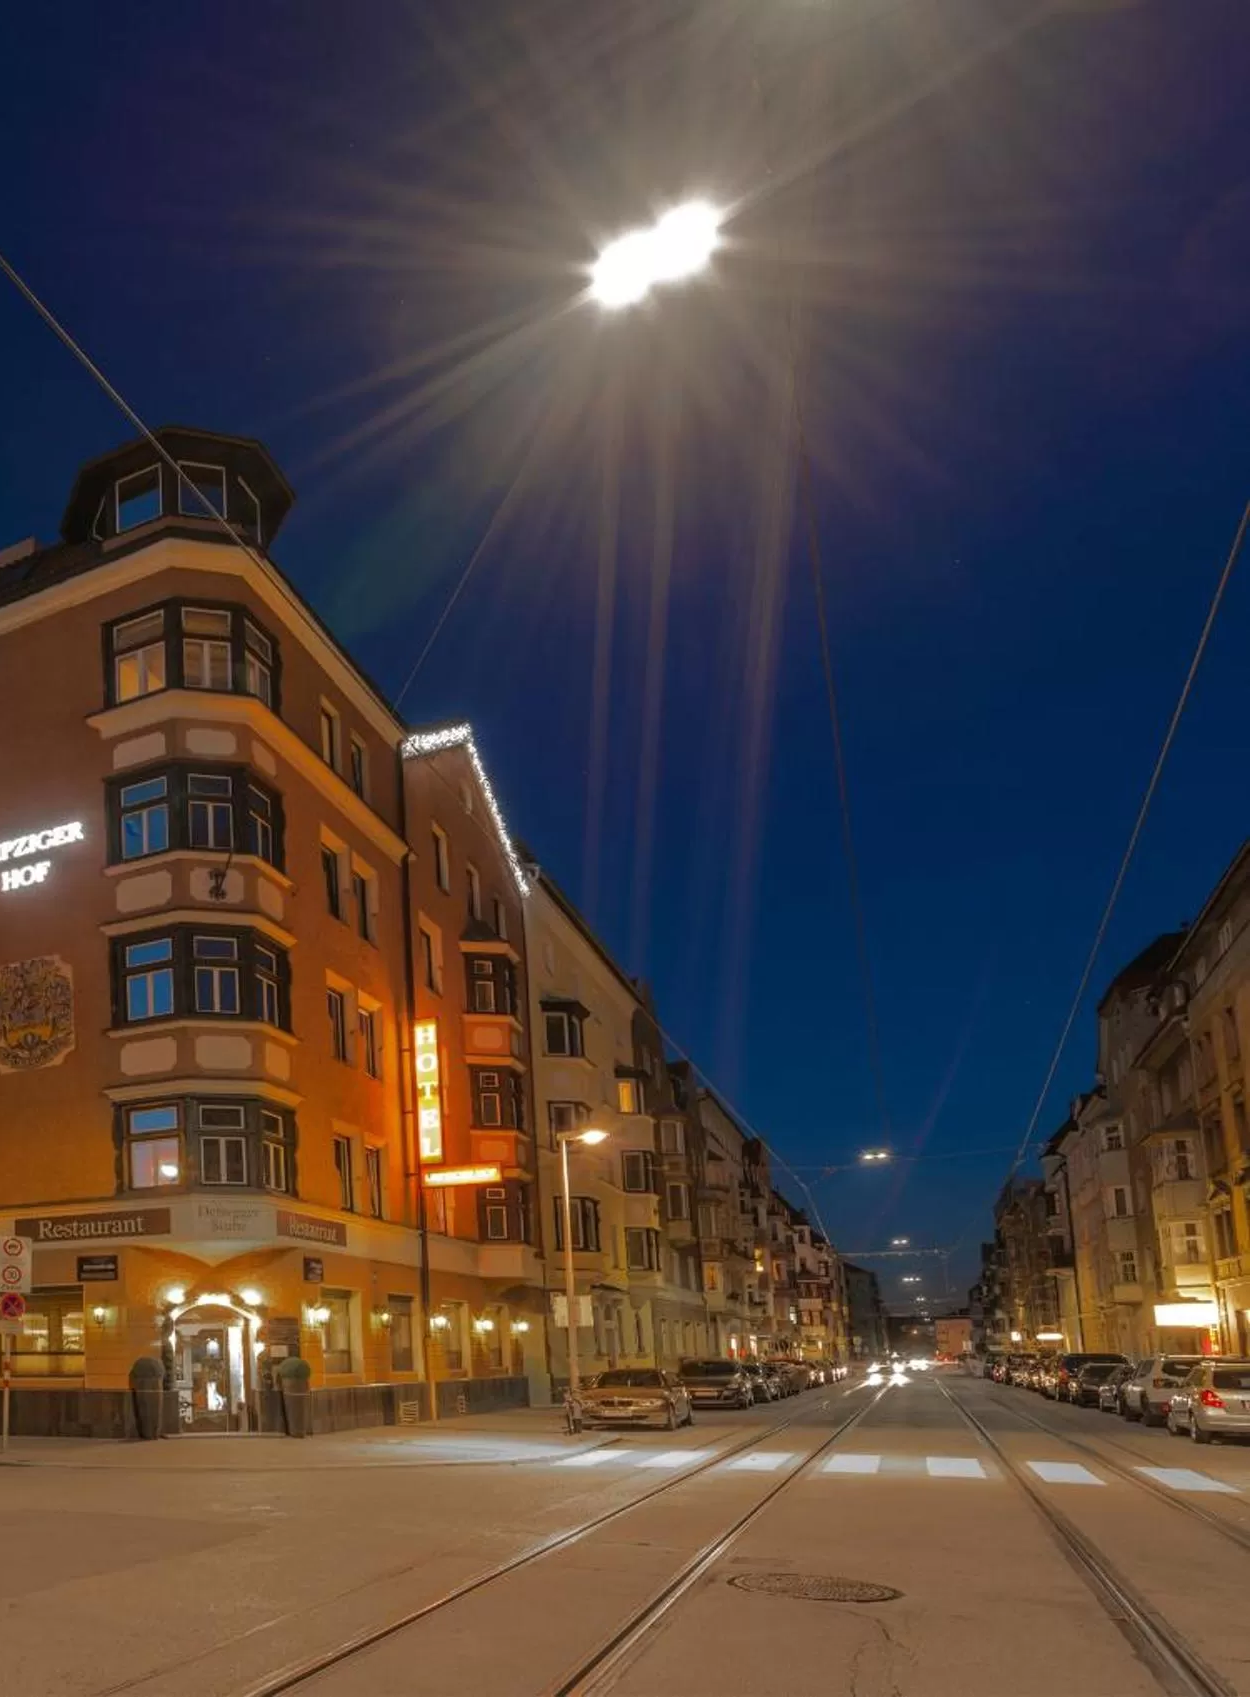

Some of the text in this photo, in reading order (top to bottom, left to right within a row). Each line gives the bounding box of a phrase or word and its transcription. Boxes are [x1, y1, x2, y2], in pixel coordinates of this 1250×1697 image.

[0, 860, 51, 891] HOF
[415, 1023, 443, 1157] HOTEL
[38, 1216, 145, 1239] Restaurant
